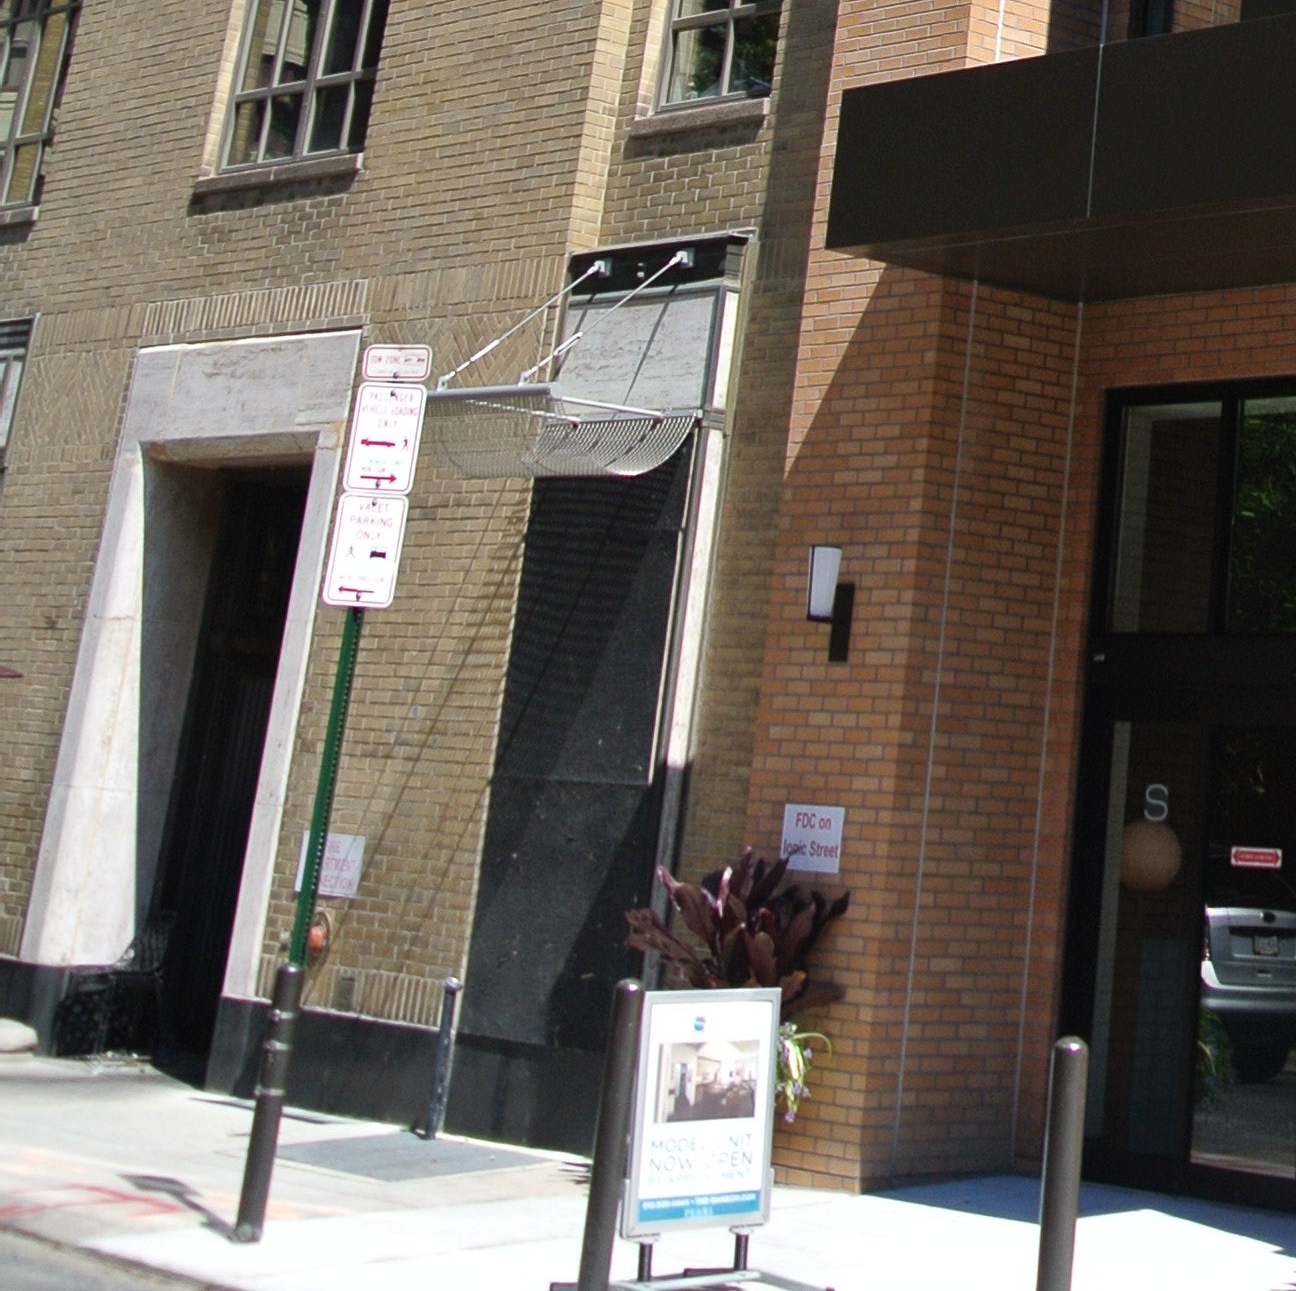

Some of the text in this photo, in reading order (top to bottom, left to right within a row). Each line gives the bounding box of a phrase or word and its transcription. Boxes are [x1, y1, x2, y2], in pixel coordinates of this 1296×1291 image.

[369, 391, 415, 403] PASSNGER
[360, 502, 389, 514] VALET
[349, 514, 393, 528] PARKING
[356, 528, 382, 541] ONLY
[1143, 783, 1170, 822] S
[795, 811, 832, 830] FDC on
[809, 840, 838, 859] Street
[648, 1150, 753, 1172] NOW OPEN
